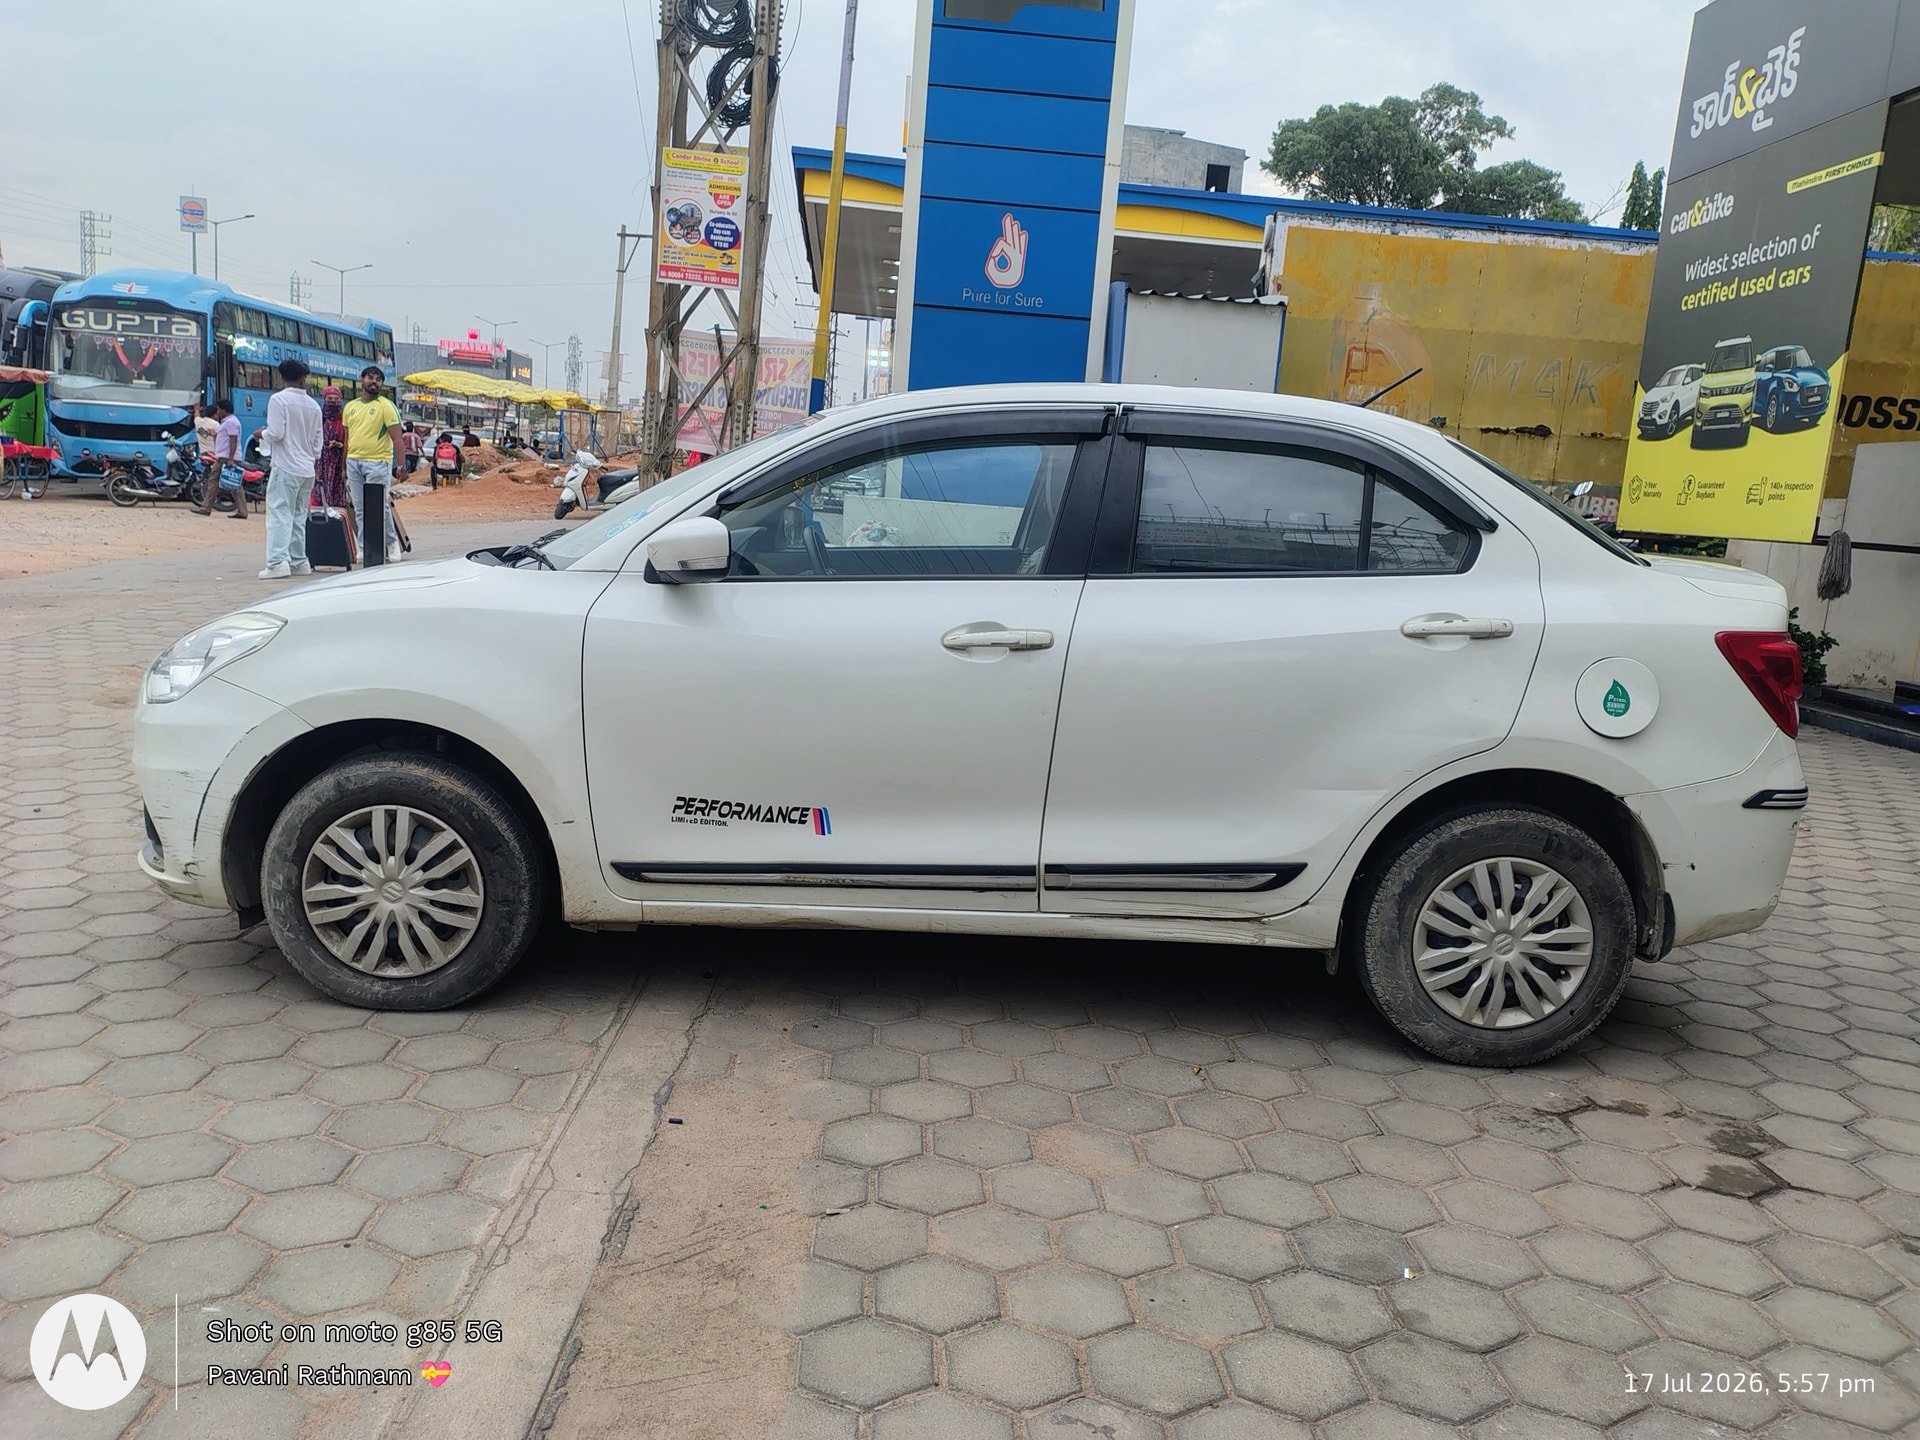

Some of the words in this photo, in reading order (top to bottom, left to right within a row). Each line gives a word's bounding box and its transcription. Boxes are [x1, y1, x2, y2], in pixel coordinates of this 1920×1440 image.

[671, 152, 692, 161] Candor
[693, 155, 711, 163] Shrine
[720, 158, 739, 166] School
[1792, 174, 1823, 191] Mahindra
[1824, 166, 1846, 180] FIRST
[1845, 156, 1874, 173] CHOICE
[709, 182, 742, 192] ADMISSIONS
[716, 199, 732, 207] OPEN
[1670, 192, 1735, 235] car&bike
[709, 221, 736, 230] Co-education
[710, 234, 734, 242] Residential
[1685, 256, 1729, 282] Widest
[1730, 236, 1797, 271] selection
[1801, 223, 1821, 251] of
[1681, 277, 1739, 311] certified
[1740, 268, 1776, 297] used
[1778, 265, 1812, 289] cars
[962, 288, 991, 304] Pure
[995, 291, 1011, 305] for
[1015, 292, 1043, 308] Sure
[439, 339, 505, 353] ROYALOAK
[1836, 393, 1920, 432] OSS
[1697, 481, 1725, 489] Guaranteed
[1770, 482, 1783, 490] 140+
[1784, 482, 1814, 491] inspection
[1643, 490, 1662, 499] Warranty
[1696, 490, 1715, 500] Buyback
[1768, 492, 1786, 502] points
[672, 796, 811, 825] PERFORMANCE
[699, 818, 729, 828] EDITION.
